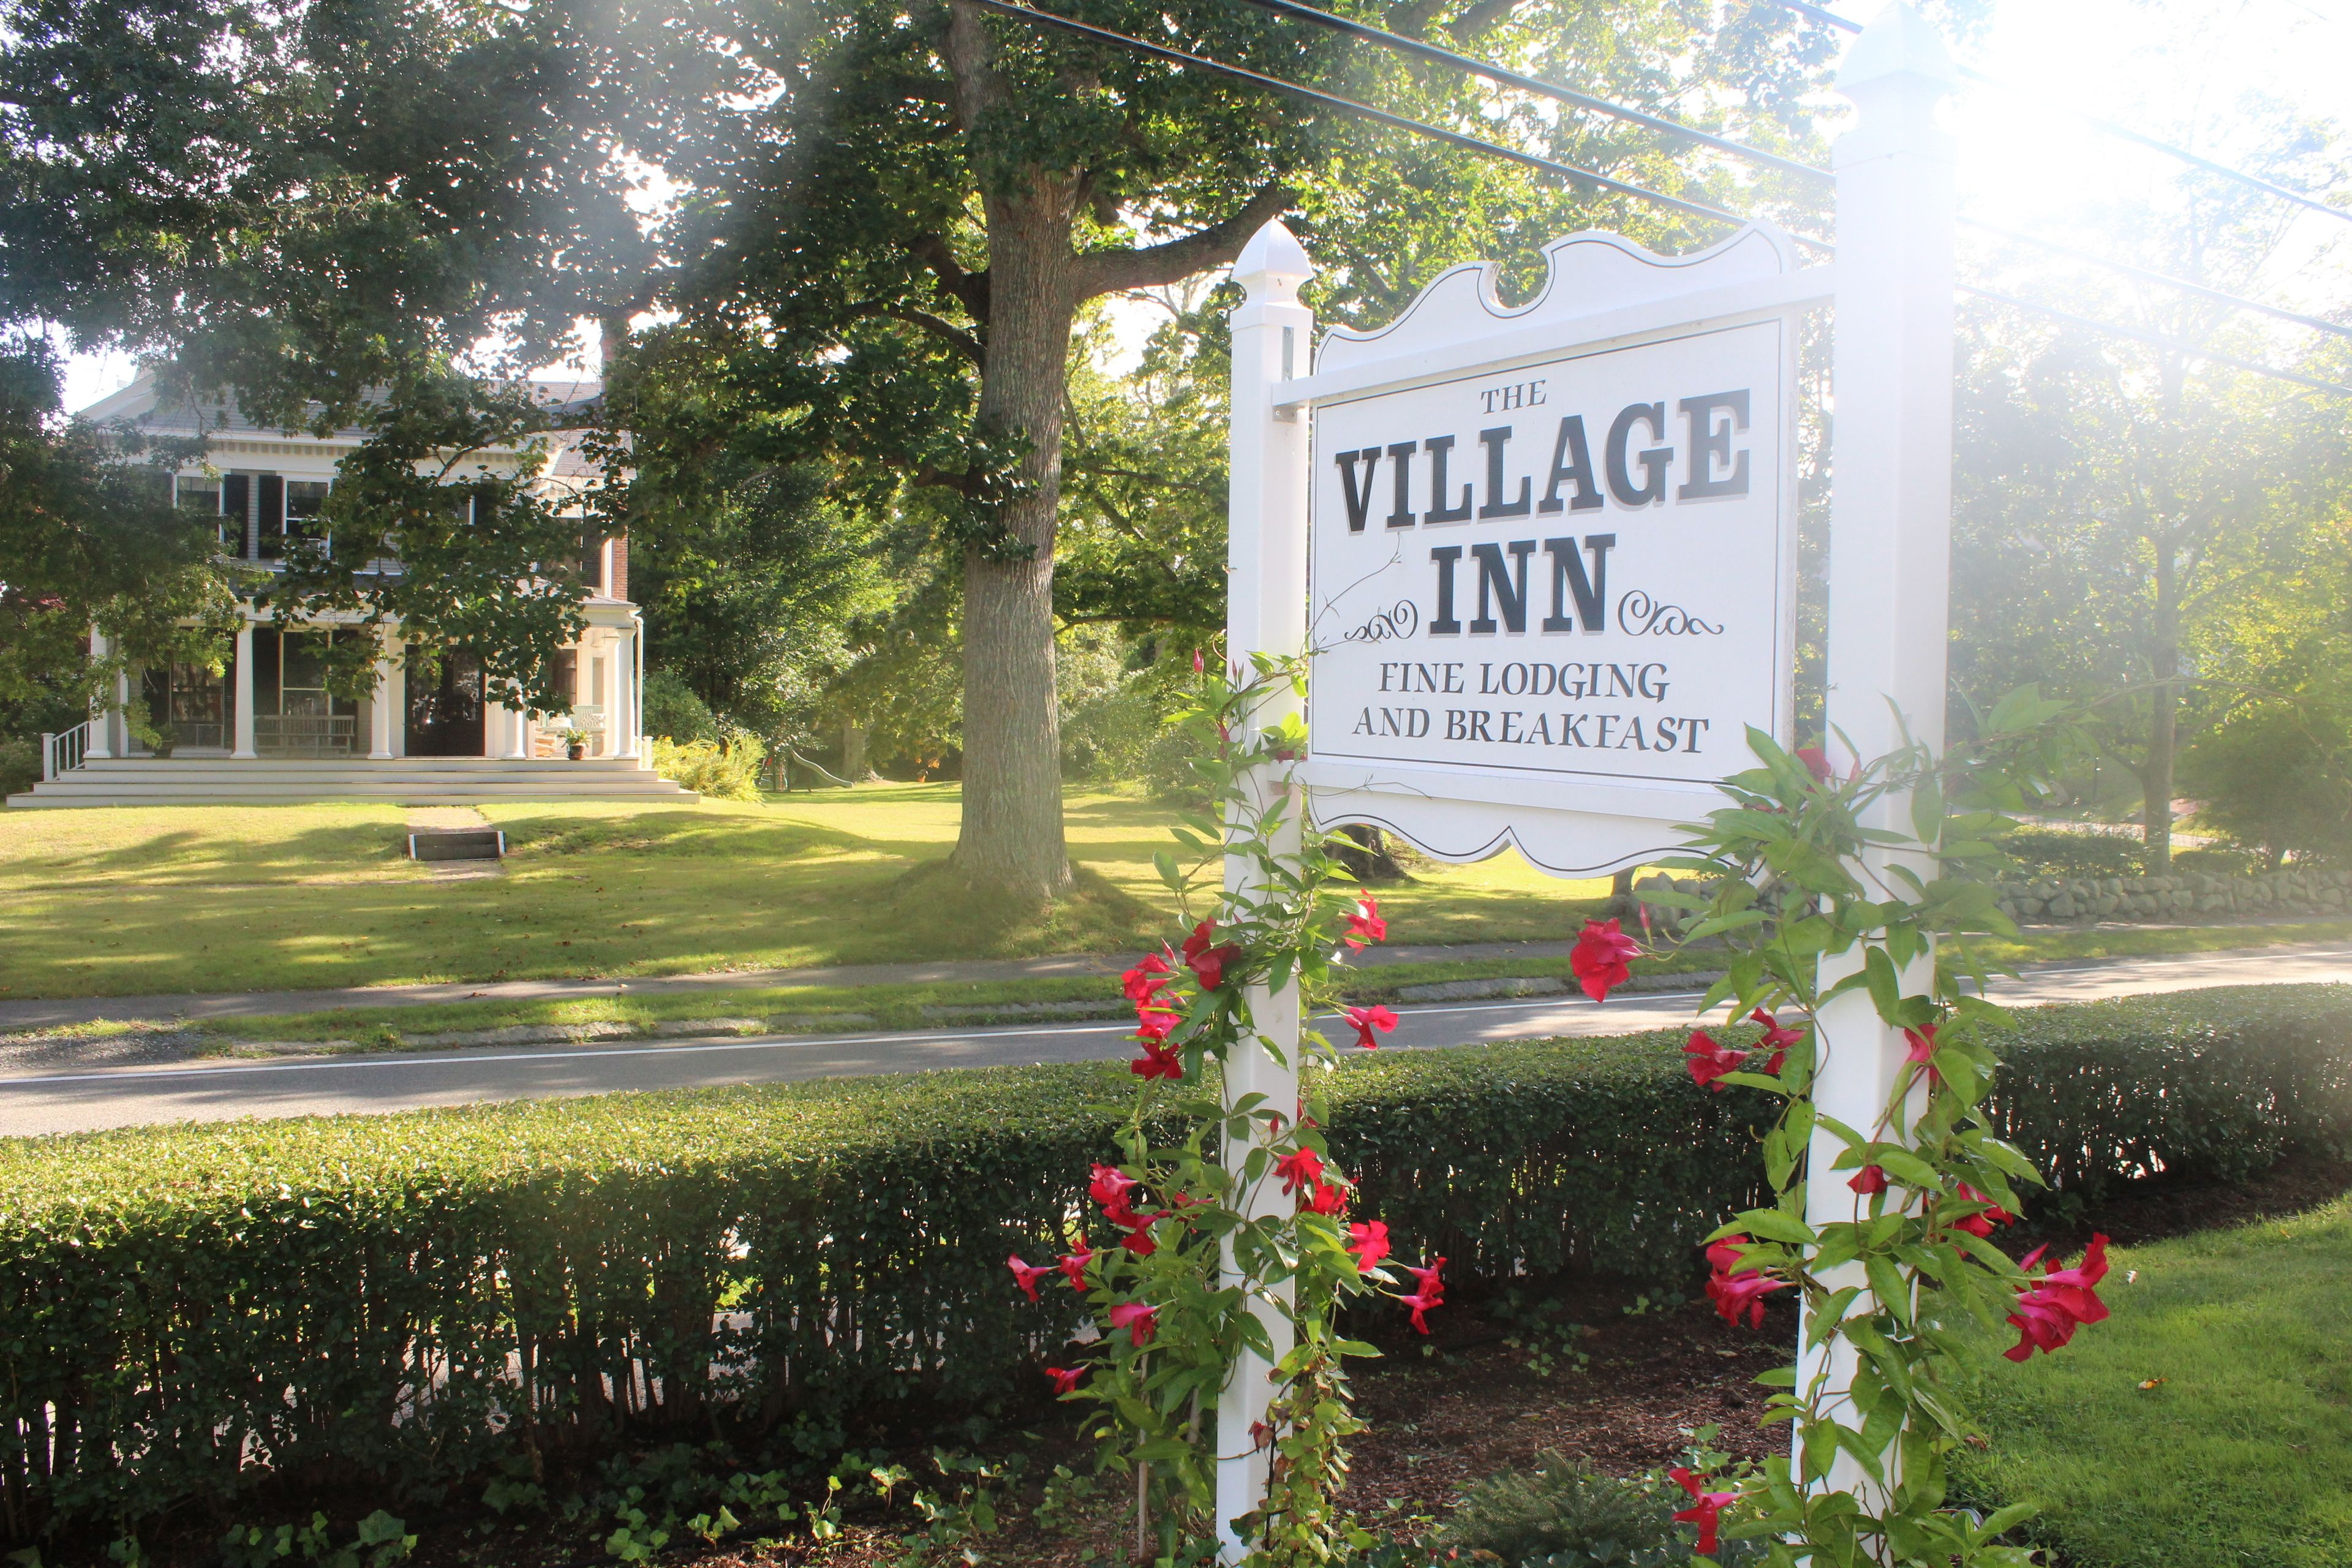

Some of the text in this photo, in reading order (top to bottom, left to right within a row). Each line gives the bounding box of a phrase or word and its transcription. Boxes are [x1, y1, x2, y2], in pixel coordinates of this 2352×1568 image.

[1480, 380, 1547, 415] THE
[1334, 388, 1750, 534] VILLAGE
[1428, 532, 1616, 638] INN
[1378, 662, 1670, 704] FINE LODGING
[1351, 706, 1709, 754] AND BREAKFAST
